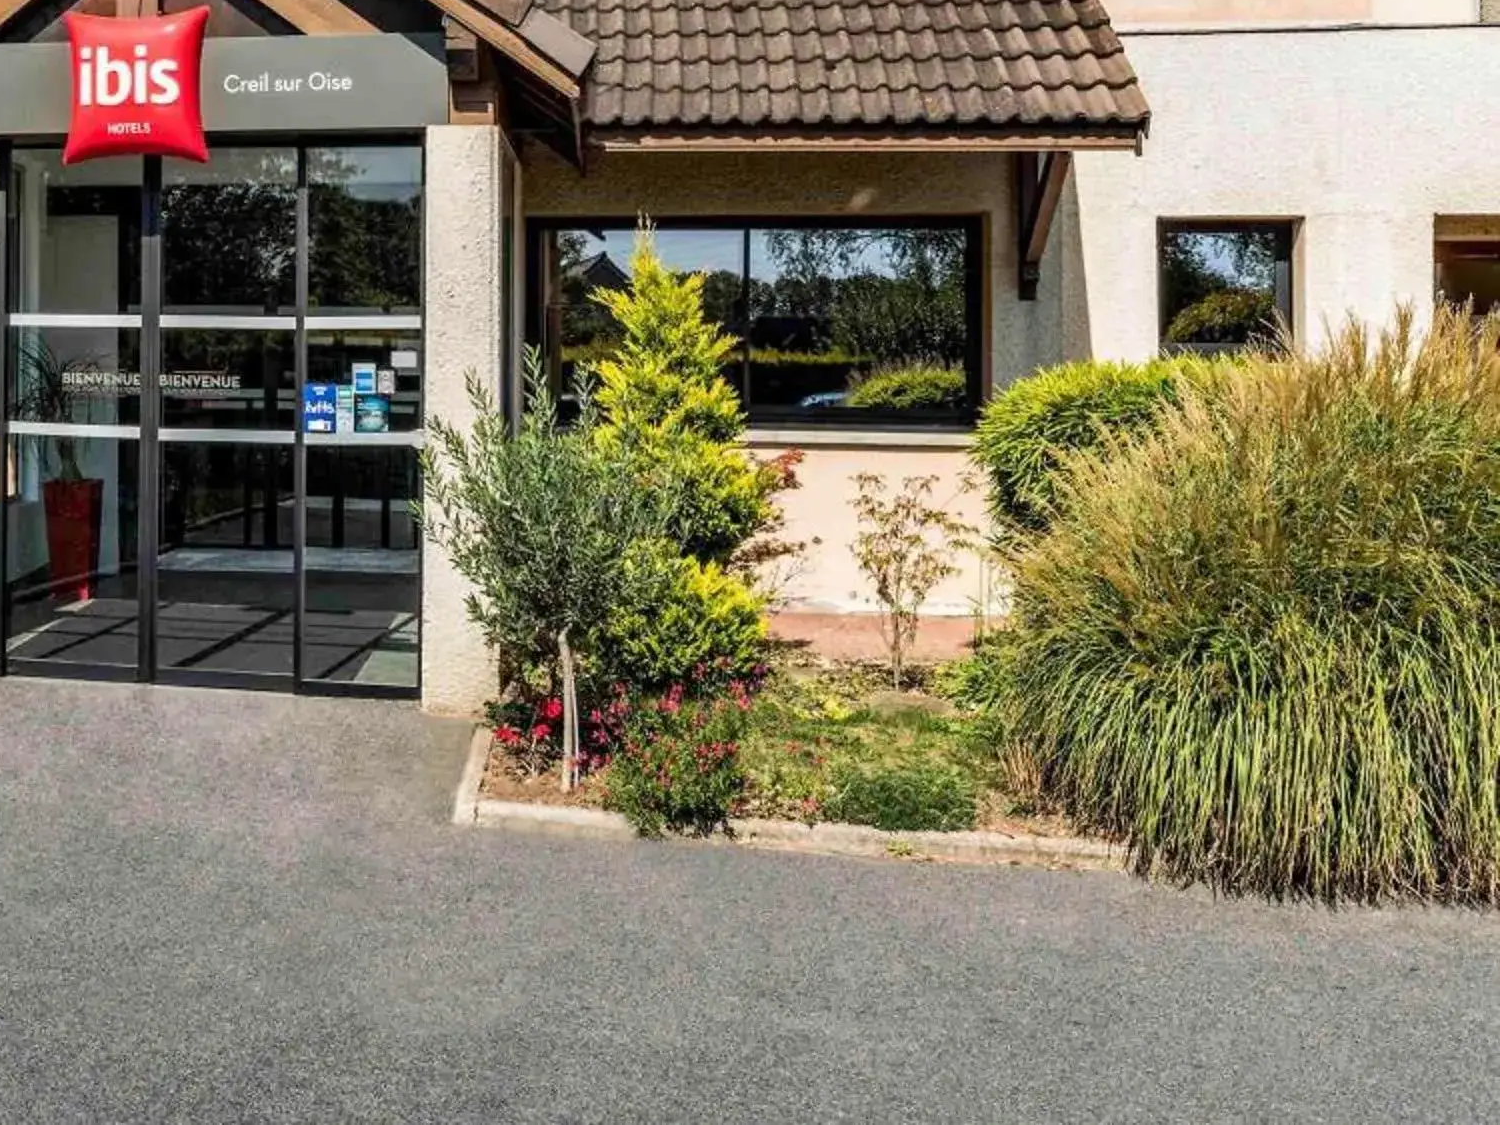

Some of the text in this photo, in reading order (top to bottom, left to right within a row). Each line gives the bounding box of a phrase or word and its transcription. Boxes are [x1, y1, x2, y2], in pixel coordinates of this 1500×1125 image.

[80, 44, 180, 106] ibis
[223, 71, 353, 93] Creil sur Oise
[107, 122, 151, 134] HOTELS
[61, 372, 141, 386] BIENVENUE
[159, 374, 241, 388] BIENVENUE
